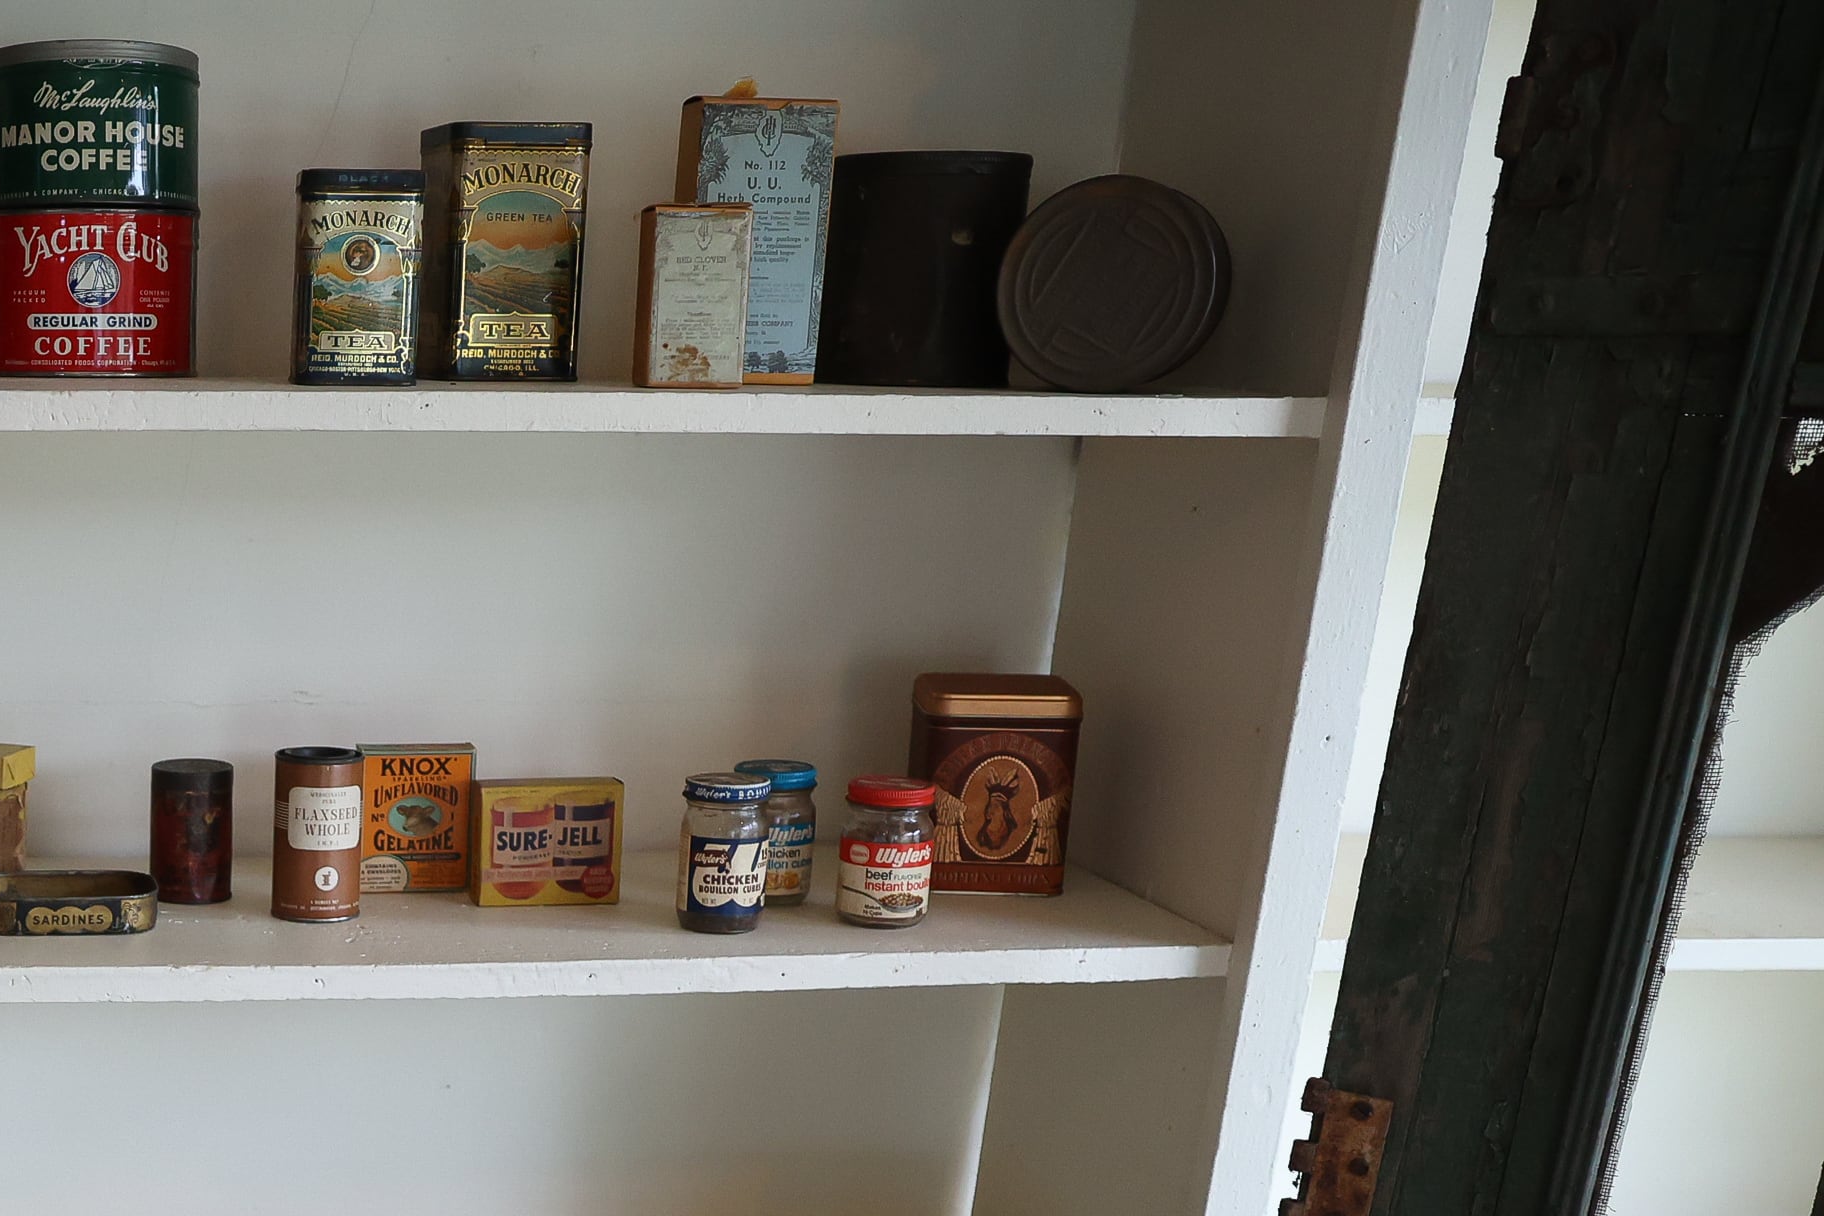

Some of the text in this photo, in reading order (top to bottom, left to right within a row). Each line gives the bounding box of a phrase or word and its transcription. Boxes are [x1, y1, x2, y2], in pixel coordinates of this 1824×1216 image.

[33, 79, 160, 115] McLaughlin's
[0, 120, 185, 149] MANOR HOUSE
[40, 148, 149, 172] COFFEE
[744, 160, 786, 171] No. 112
[460, 162, 582, 198] MONARCH
[747, 177, 782, 190] U. U.
[717, 193, 812, 206] Herb Compound
[311, 210, 411, 237] MONARCH
[486, 211, 553, 223] GREEN TEA
[13, 218, 170, 278] YACHT CLUB
[33, 315, 152, 329] REGULAR GRIND
[479, 321, 551, 340] TEA
[34, 336, 151, 356] COFFEE
[327, 335, 386, 349] TEA
[334, 354, 377, 364] MURDOCH
[488, 348, 537, 359] MURDOCH
[380, 757, 453, 777] KNOX
[373, 782, 459, 808] UNFLAVORED
[294, 806, 358, 822] FLAXSEED
[305, 822, 351, 837] WHOLE
[557, 826, 603, 847] JELL
[373, 826, 455, 851] GELATINE
[694, 851, 728, 865] Wyler's
[767, 847, 801, 858] hicken
[875, 844, 932, 868] Wyler's
[702, 873, 760, 886] CHICKEN
[865, 868, 894, 880] beef
[698, 885, 762, 894] BOUILLON CUBES
[864, 879, 905, 892] instant
[31, 914, 106, 928] SARDINES
